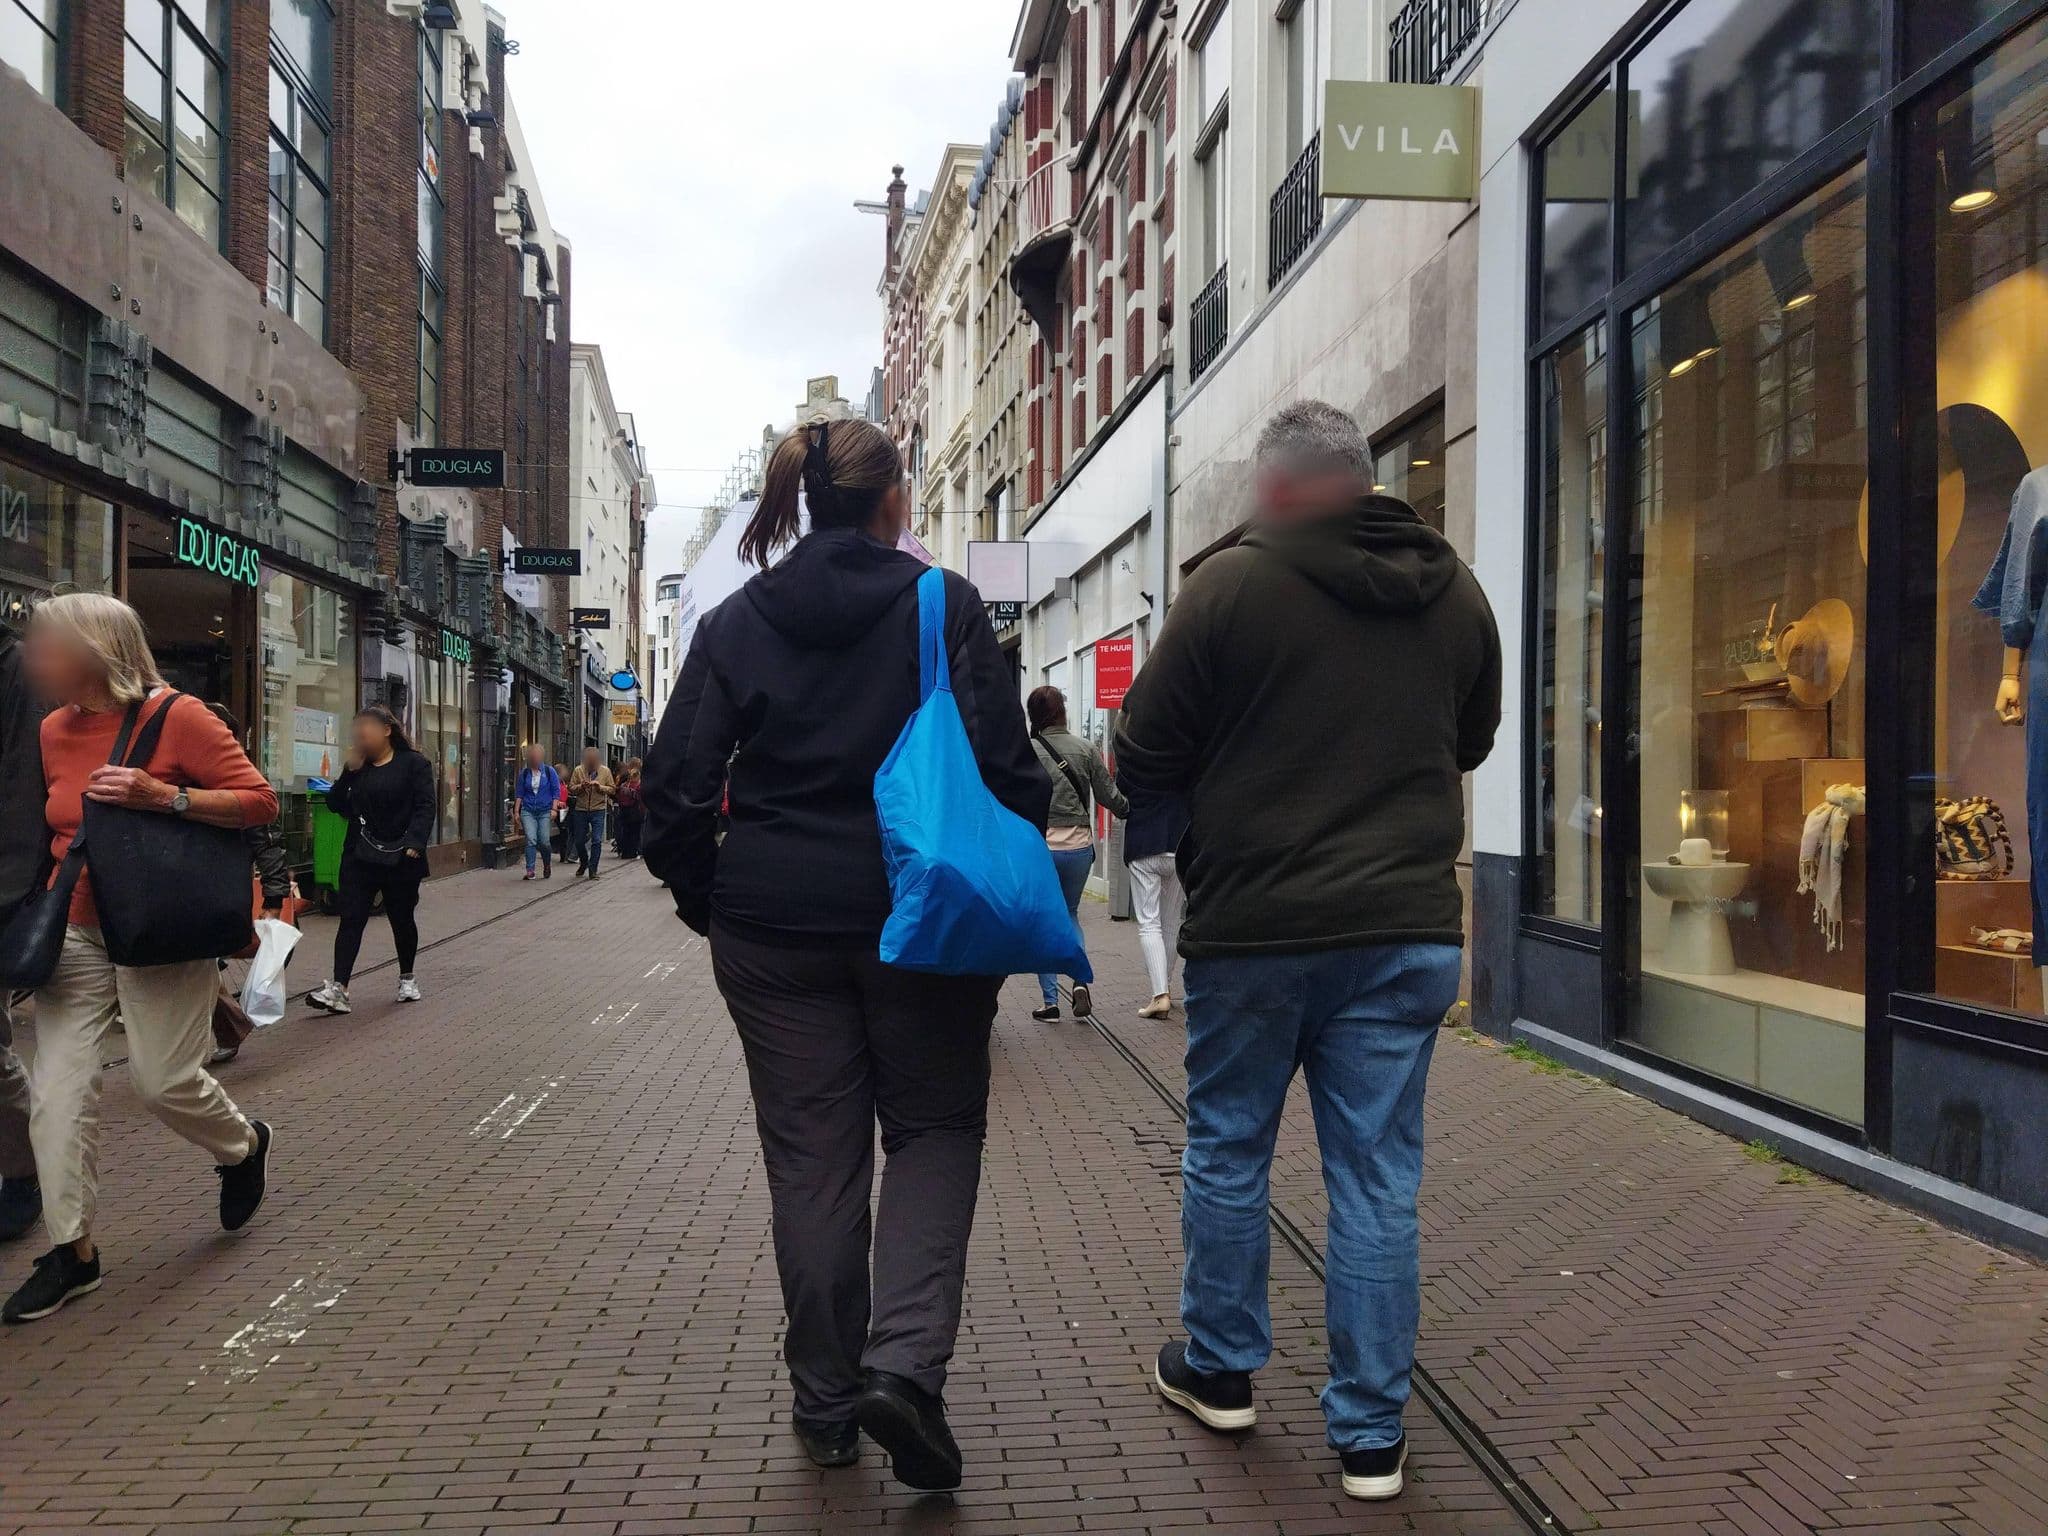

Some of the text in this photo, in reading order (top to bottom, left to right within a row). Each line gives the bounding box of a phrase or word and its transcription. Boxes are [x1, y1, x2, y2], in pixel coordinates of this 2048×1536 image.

[1337, 124, 1460, 155] VILA
[422, 459, 492, 475] DOUGLAS
[179, 518, 259, 587] DOUGLAS
[523, 555, 573, 567] DOUGLAS
[442, 629, 471, 662] DOUGLAS
[1110, 643, 1132, 652] HUUR
